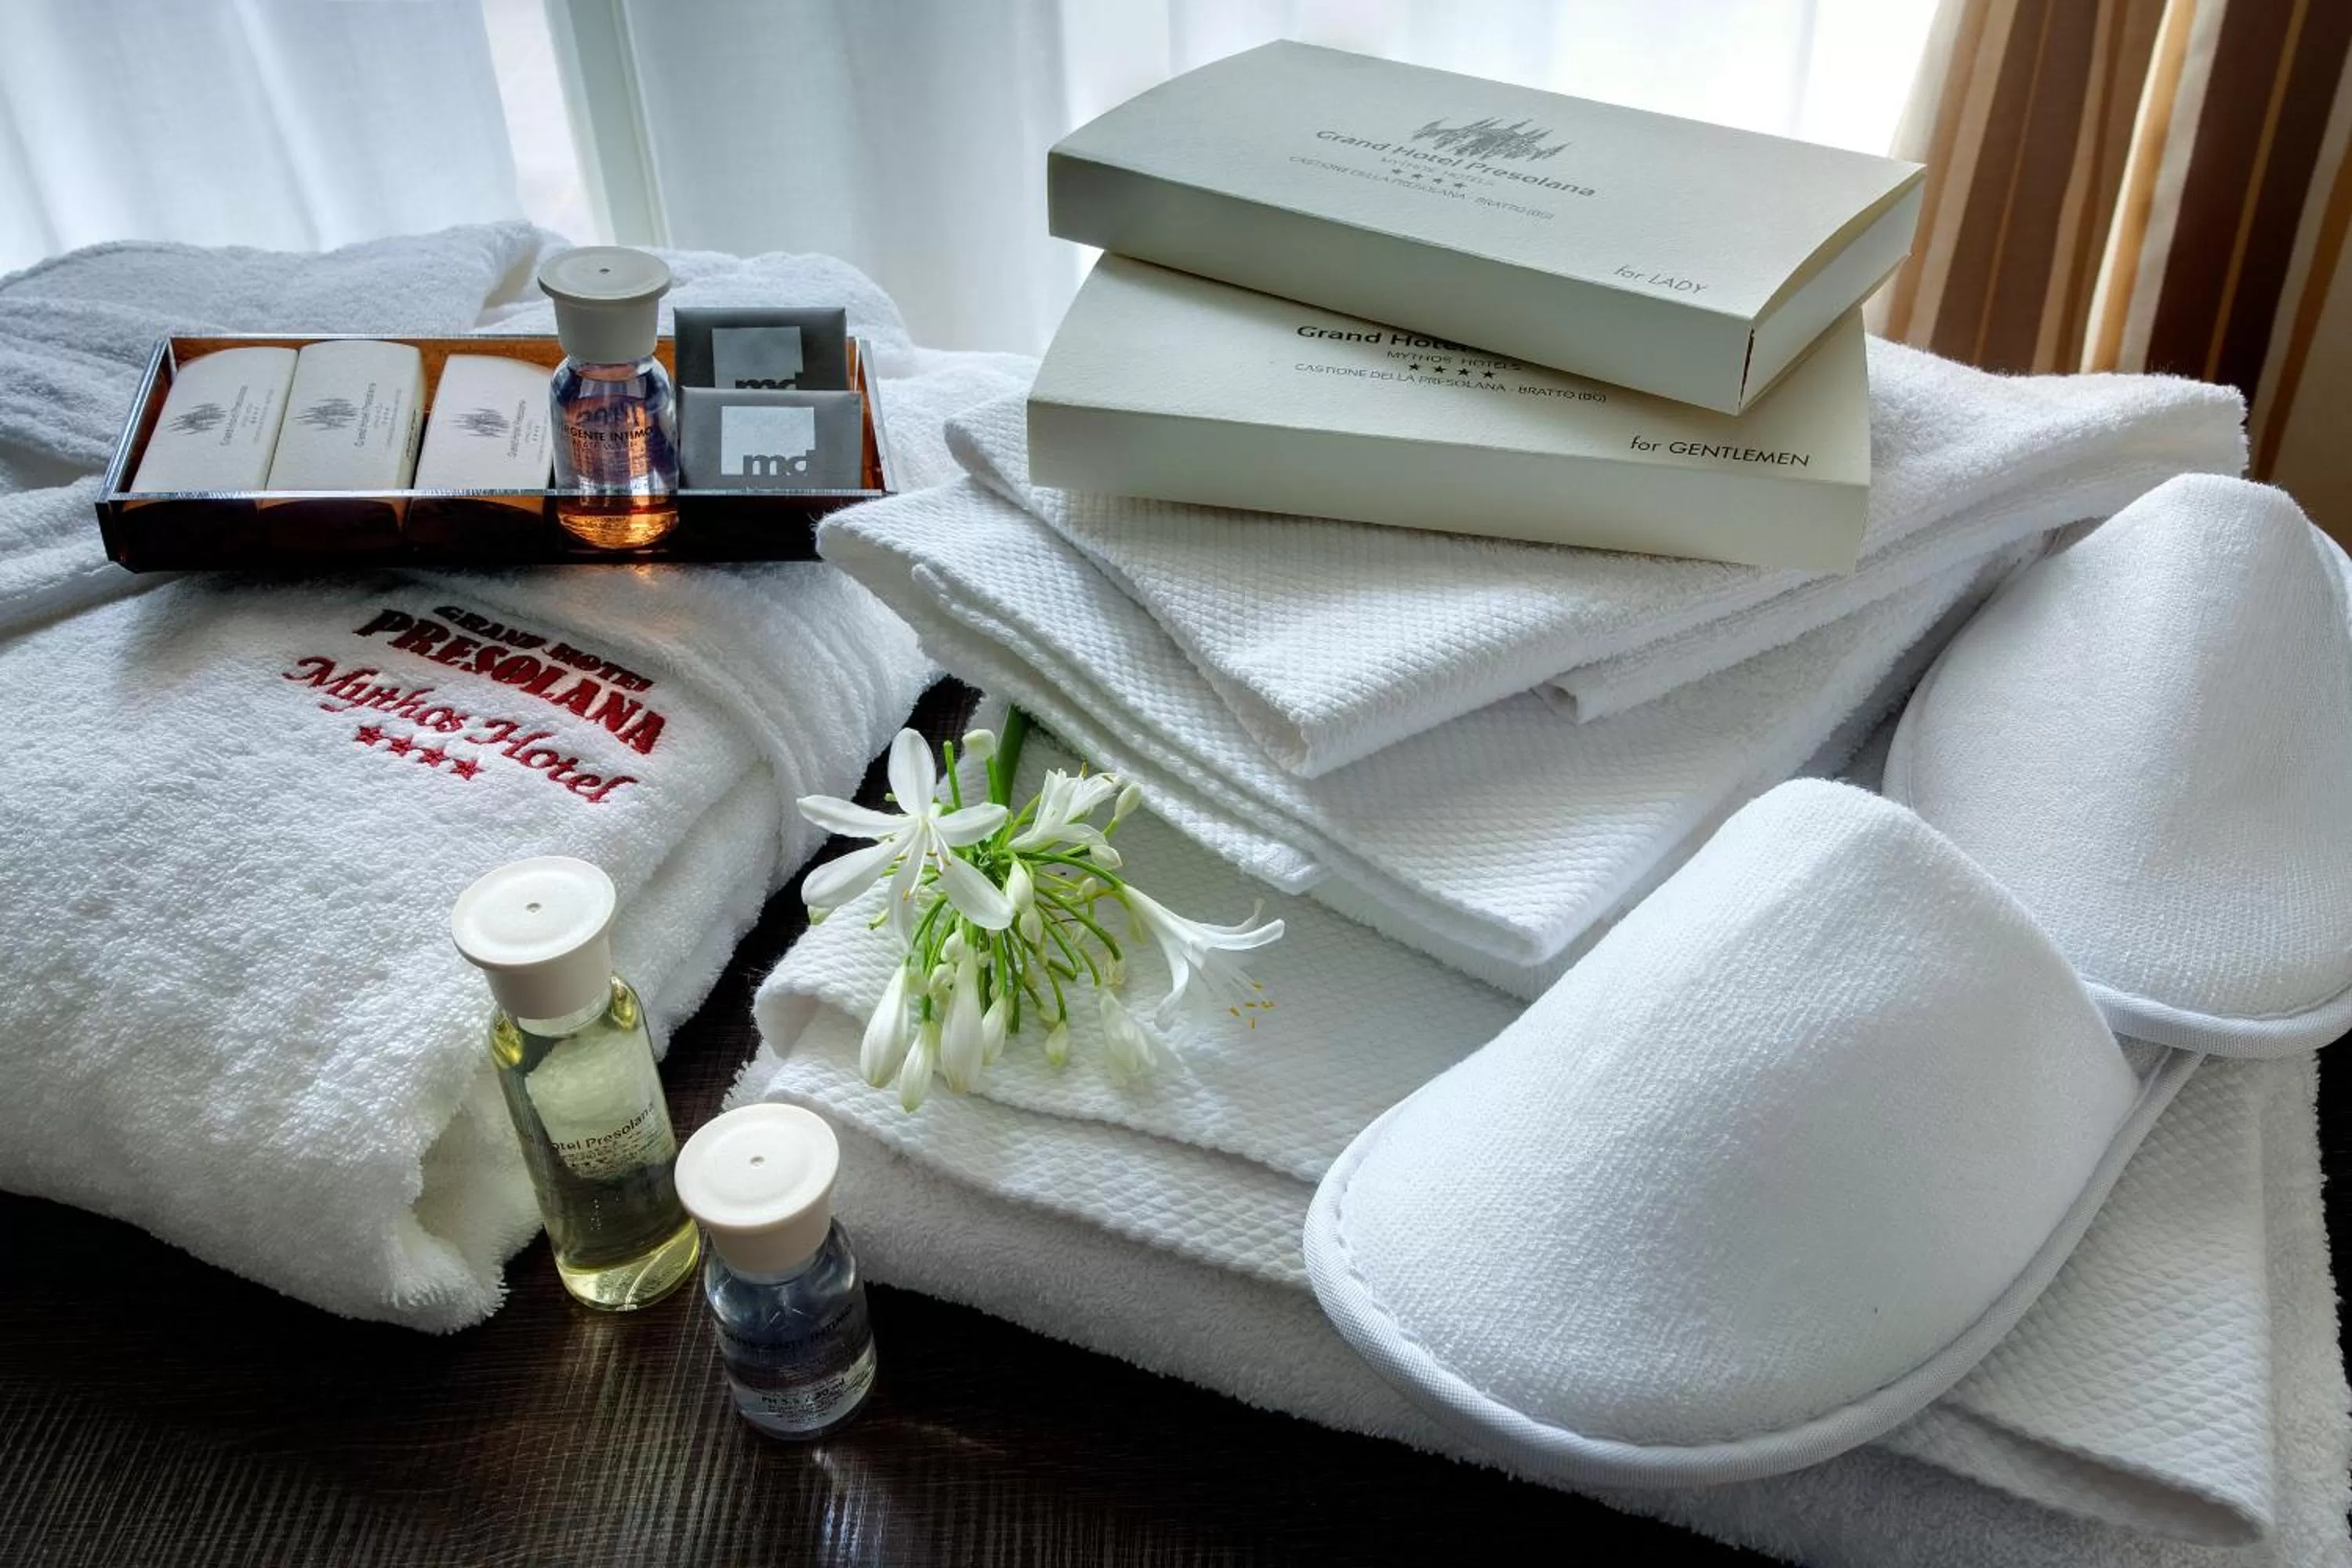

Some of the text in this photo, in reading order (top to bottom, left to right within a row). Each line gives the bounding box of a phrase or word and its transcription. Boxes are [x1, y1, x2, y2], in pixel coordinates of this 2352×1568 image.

[1316, 130, 1596, 196] Grand Hotel Presolana
[1613, 264, 1708, 294] for LADY
[1296, 325, 1466, 352] Grand Hote
[1386, 350, 1522, 371] MYTHOS HOTELS
[1294, 362, 1367, 377] CASTIONE
[1370, 370, 1415, 383] DELLA
[1417, 375, 1506, 392] PRESOLANA
[1517, 385, 1575, 399] BRATTO
[742, 448, 815, 476] md
[1630, 434, 1810, 467] for GENTLEMEN
[433, 604, 655, 693] GRAND HOTEL
[352, 608, 666, 755] PRESOLANA
[464, 717, 640, 804] Hotel
[585, 1100, 655, 1149] Presolana
